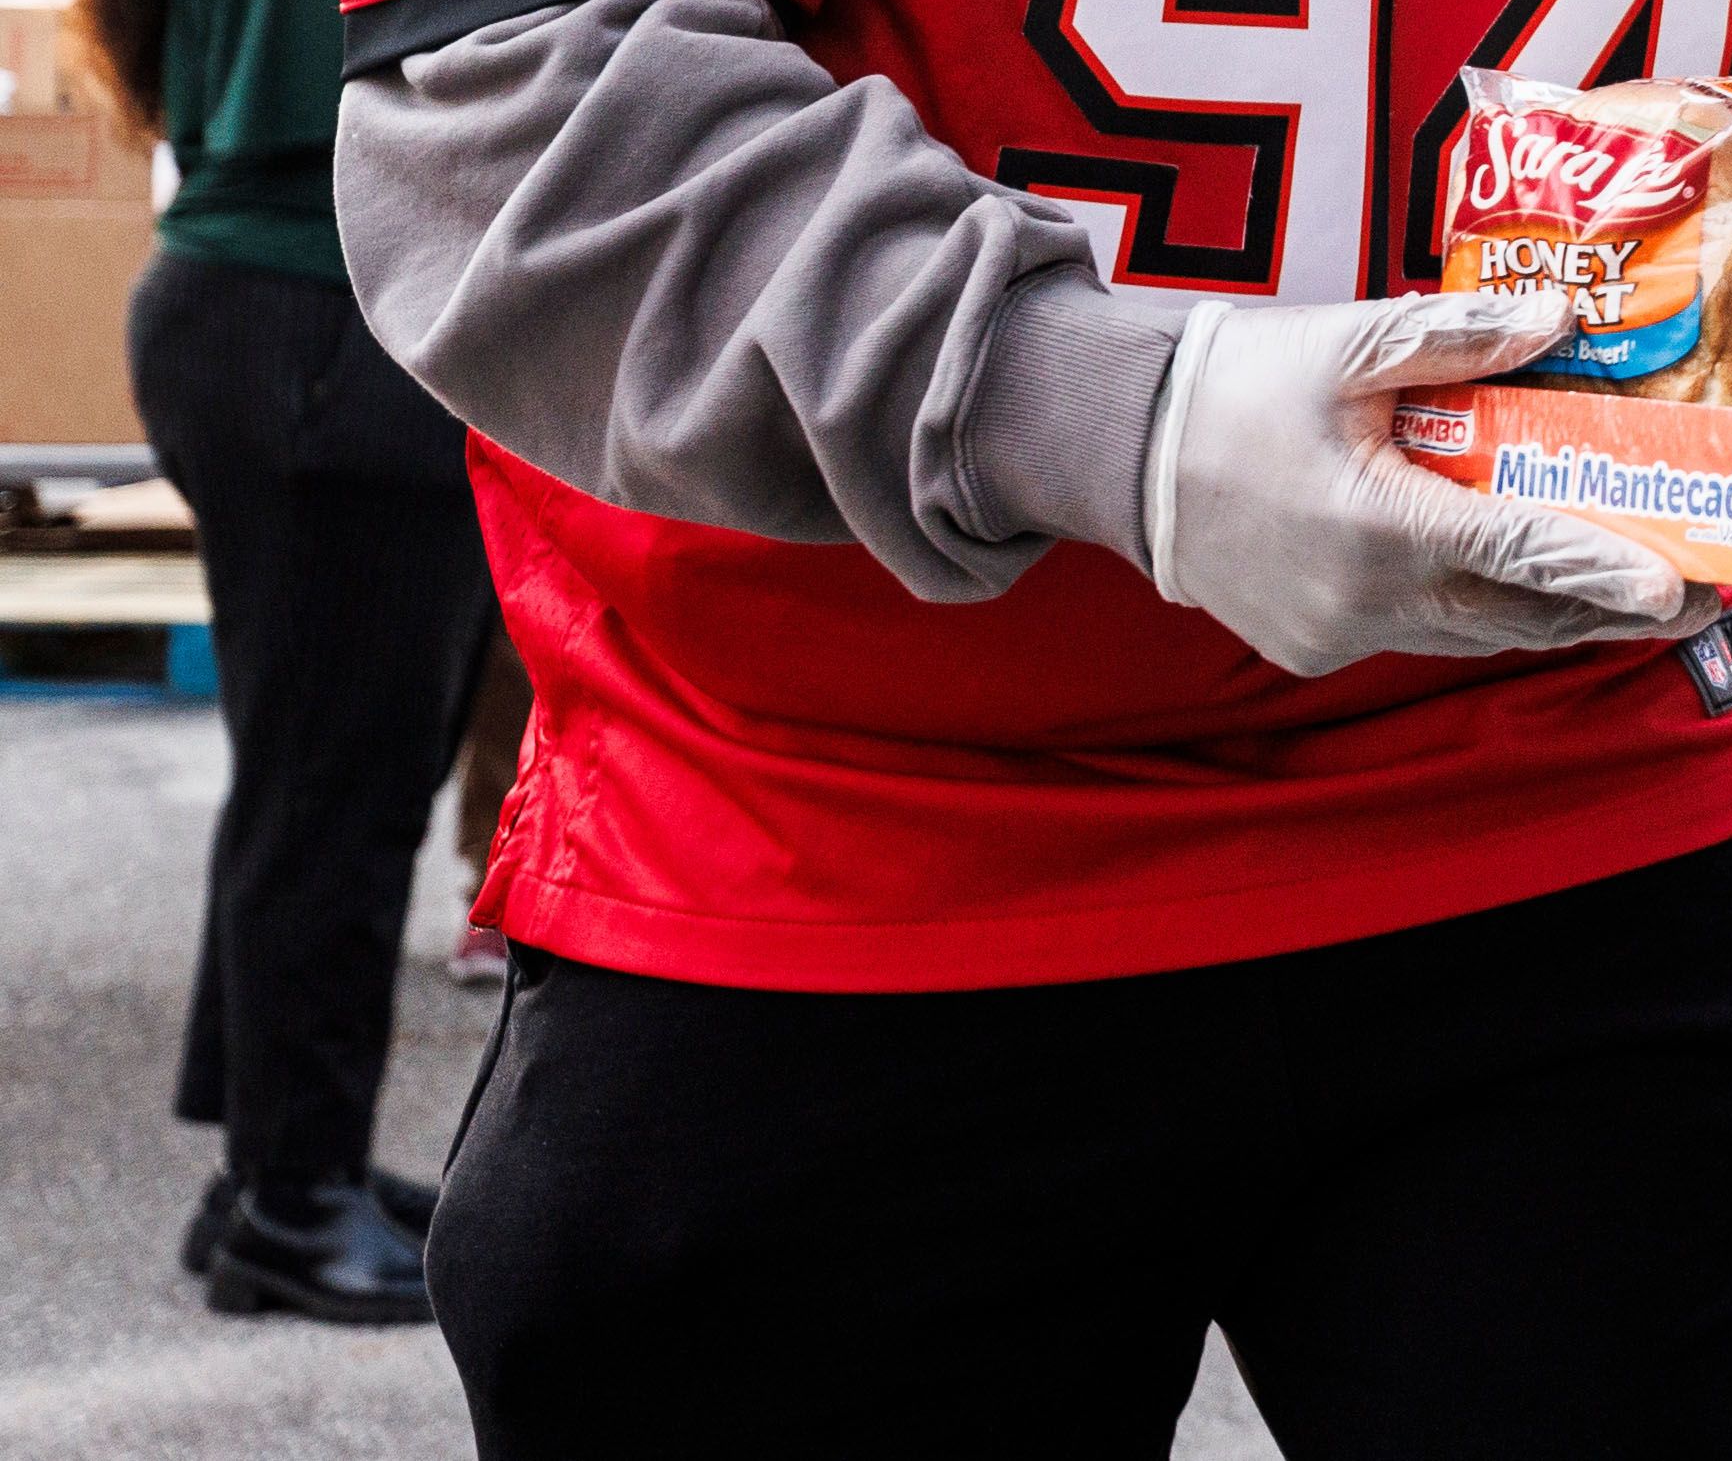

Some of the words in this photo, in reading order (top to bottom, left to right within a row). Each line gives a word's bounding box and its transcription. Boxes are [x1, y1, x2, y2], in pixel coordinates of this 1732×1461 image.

[1470, 114, 1615, 209] Sara
[1479, 236, 1642, 285] HONEY
[1391, 415, 1467, 444] BIMBO
[1496, 447, 1571, 502] Mini
